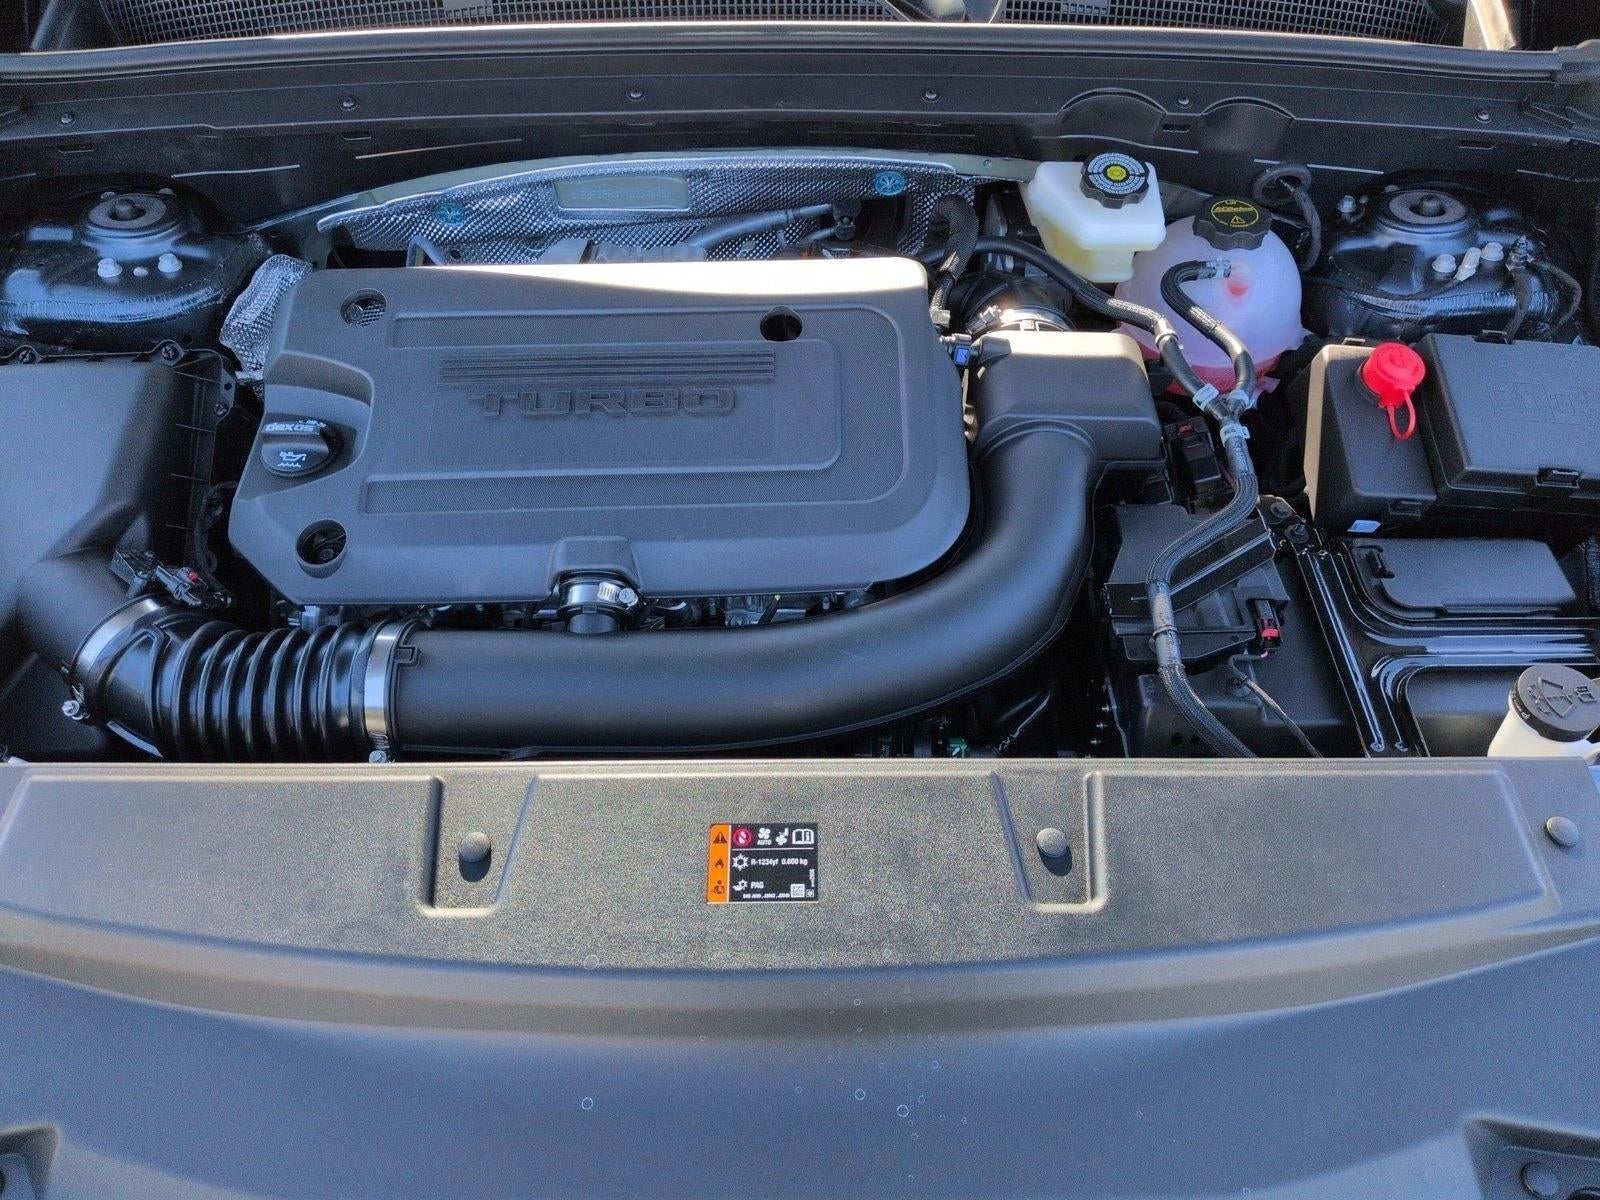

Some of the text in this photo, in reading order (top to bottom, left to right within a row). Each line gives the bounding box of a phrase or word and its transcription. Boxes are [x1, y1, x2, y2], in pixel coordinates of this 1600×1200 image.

[467, 388, 736, 416] TURBO
[750, 858, 779, 867] R-1234yf
[799, 858, 808, 867] kg
[750, 881, 764, 890] PAG
